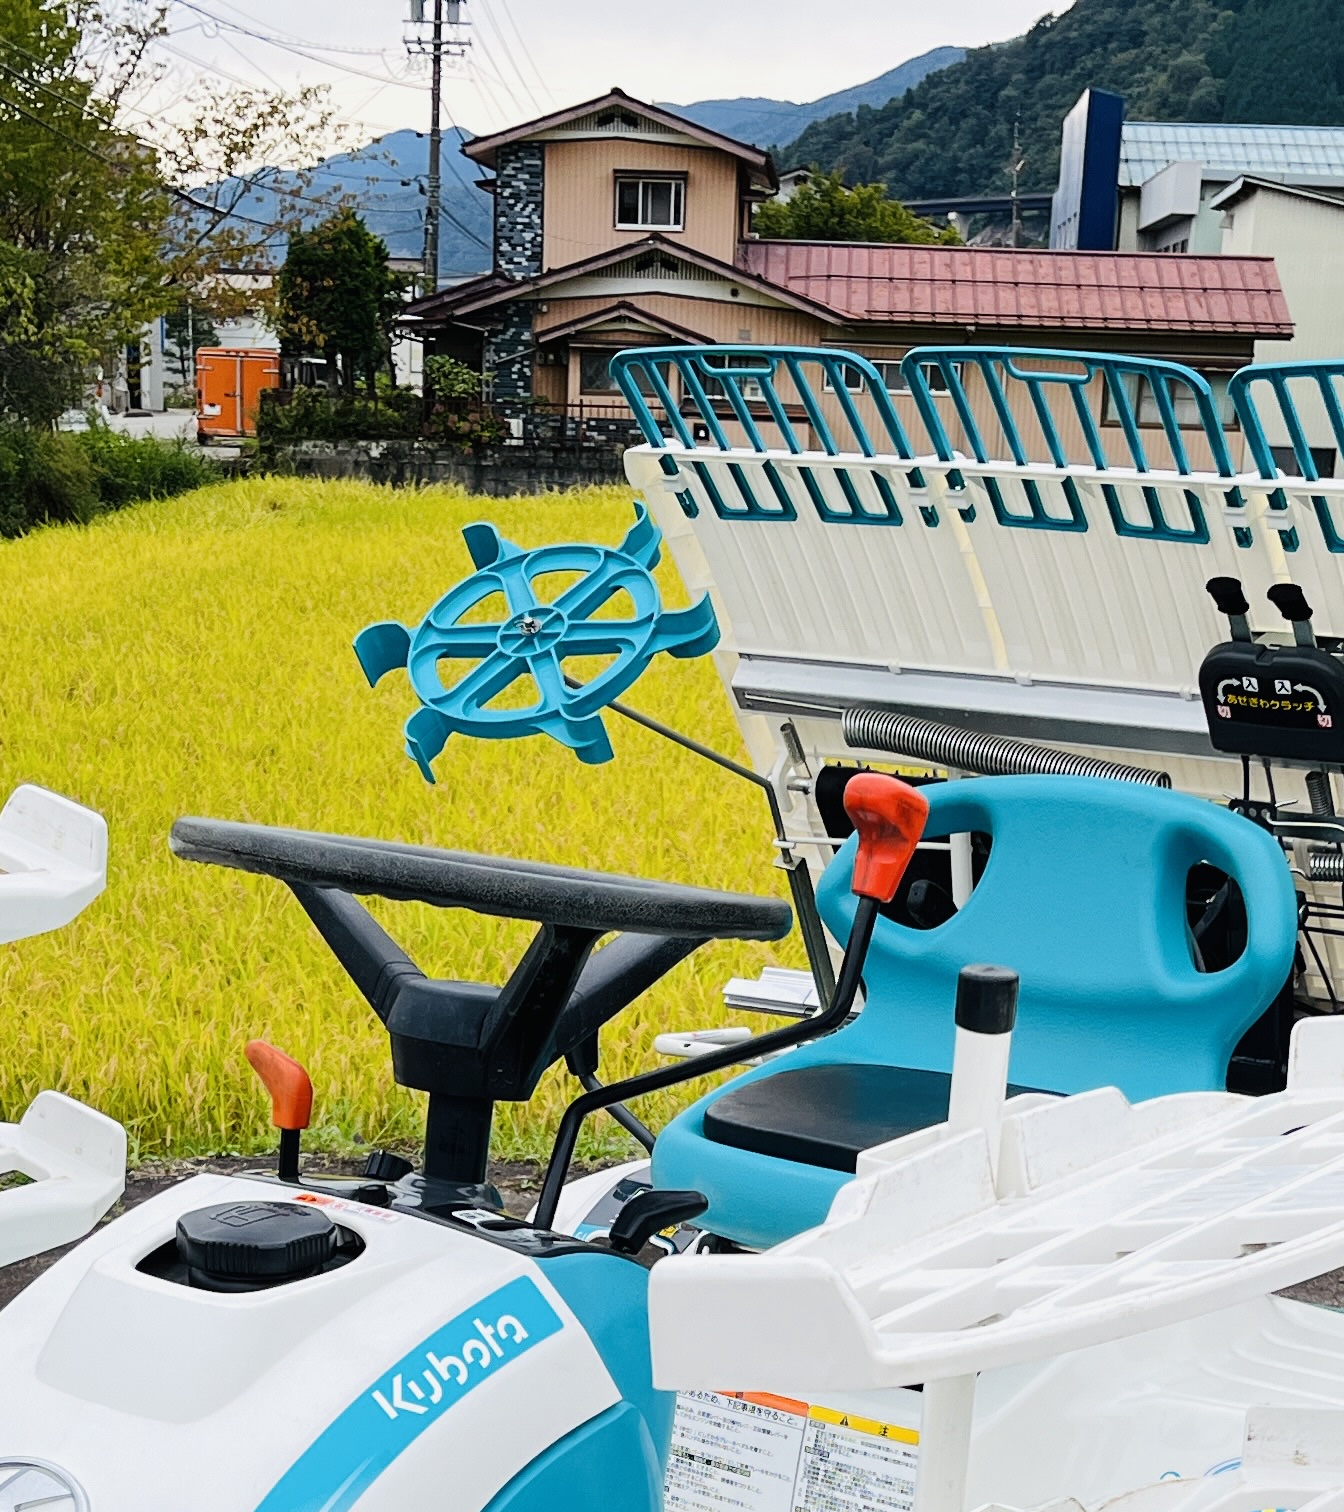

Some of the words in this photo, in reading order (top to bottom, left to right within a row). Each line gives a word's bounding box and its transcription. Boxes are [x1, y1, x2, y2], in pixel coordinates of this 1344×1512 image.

[1244, 677, 1257, 691] 入
[1276, 681, 1290, 693] 入
[371, 1314, 529, 1420] Kubota
